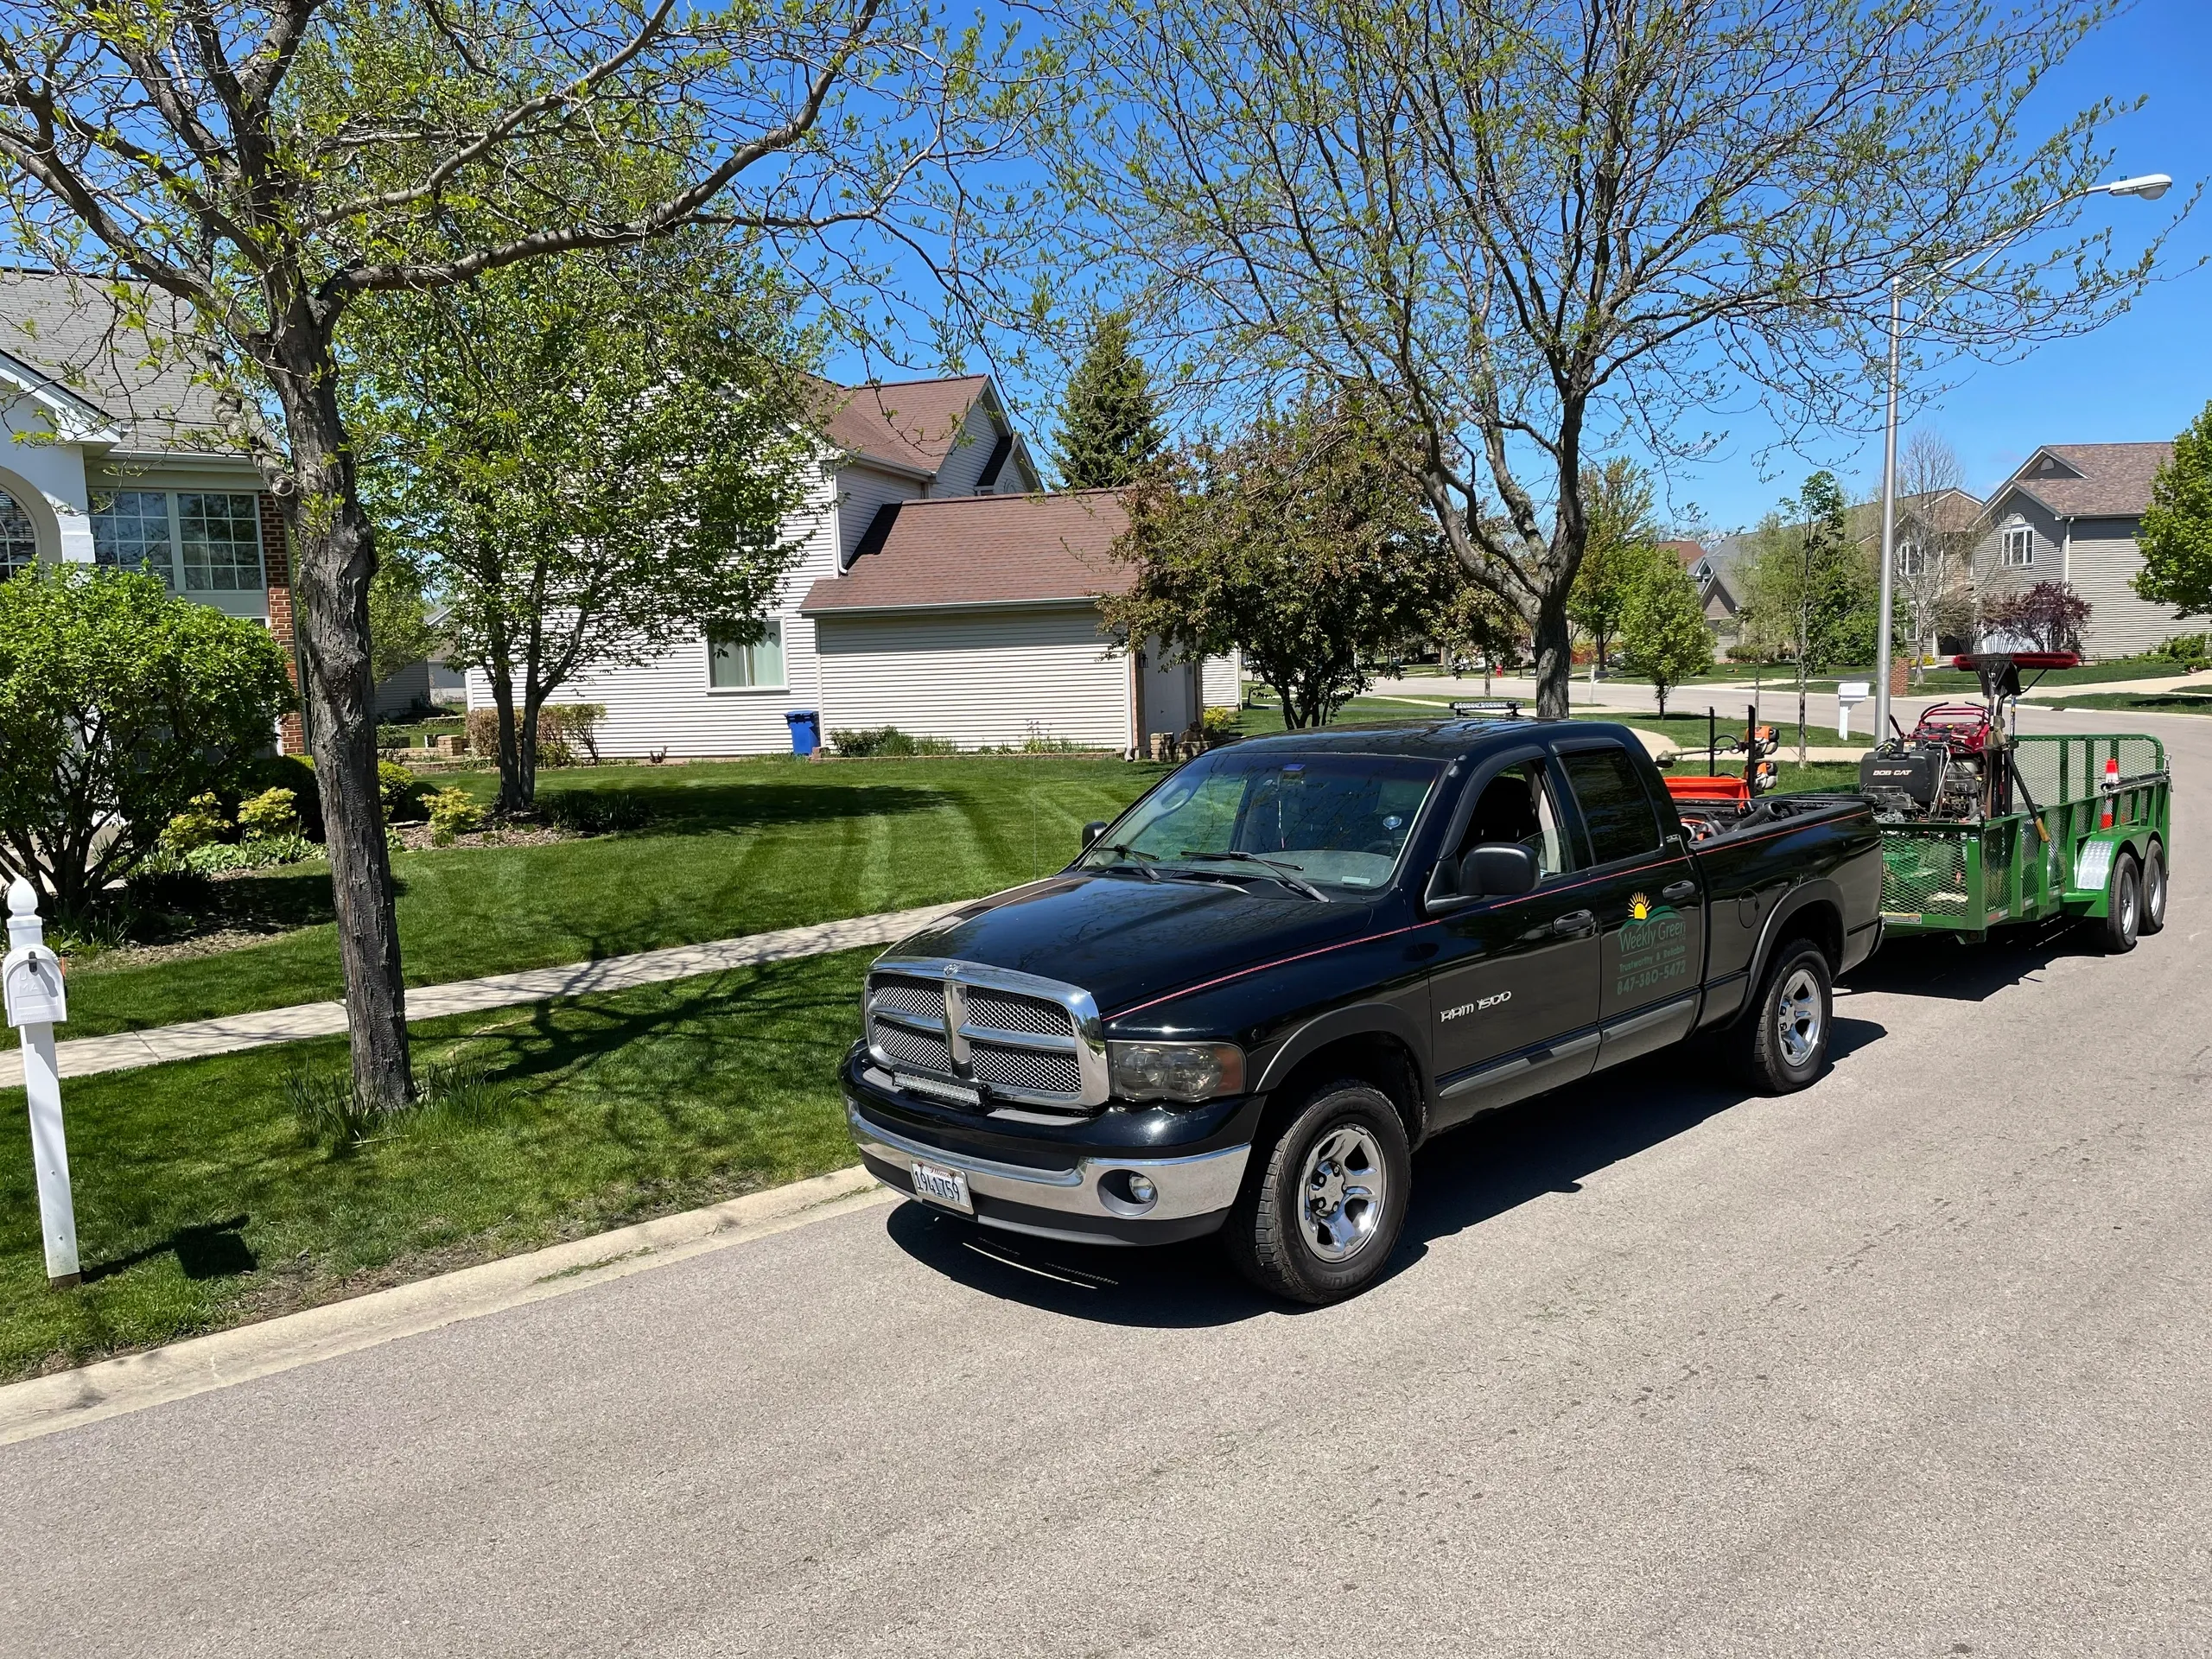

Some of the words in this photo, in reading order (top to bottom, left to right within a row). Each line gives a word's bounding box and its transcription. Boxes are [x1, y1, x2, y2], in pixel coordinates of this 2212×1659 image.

[1618, 925, 1656, 952] Weekly
[1658, 921, 1687, 941] Green
[1618, 955, 1653, 972] Trustworthy
[1662, 944, 1686, 959] Reliable
[1617, 959, 1687, 996] 847-380-5472
[1440, 1003, 1474, 1023] RAM
[1477, 990, 1512, 1010] 1500
[915, 1171, 960, 1201] 1941759
